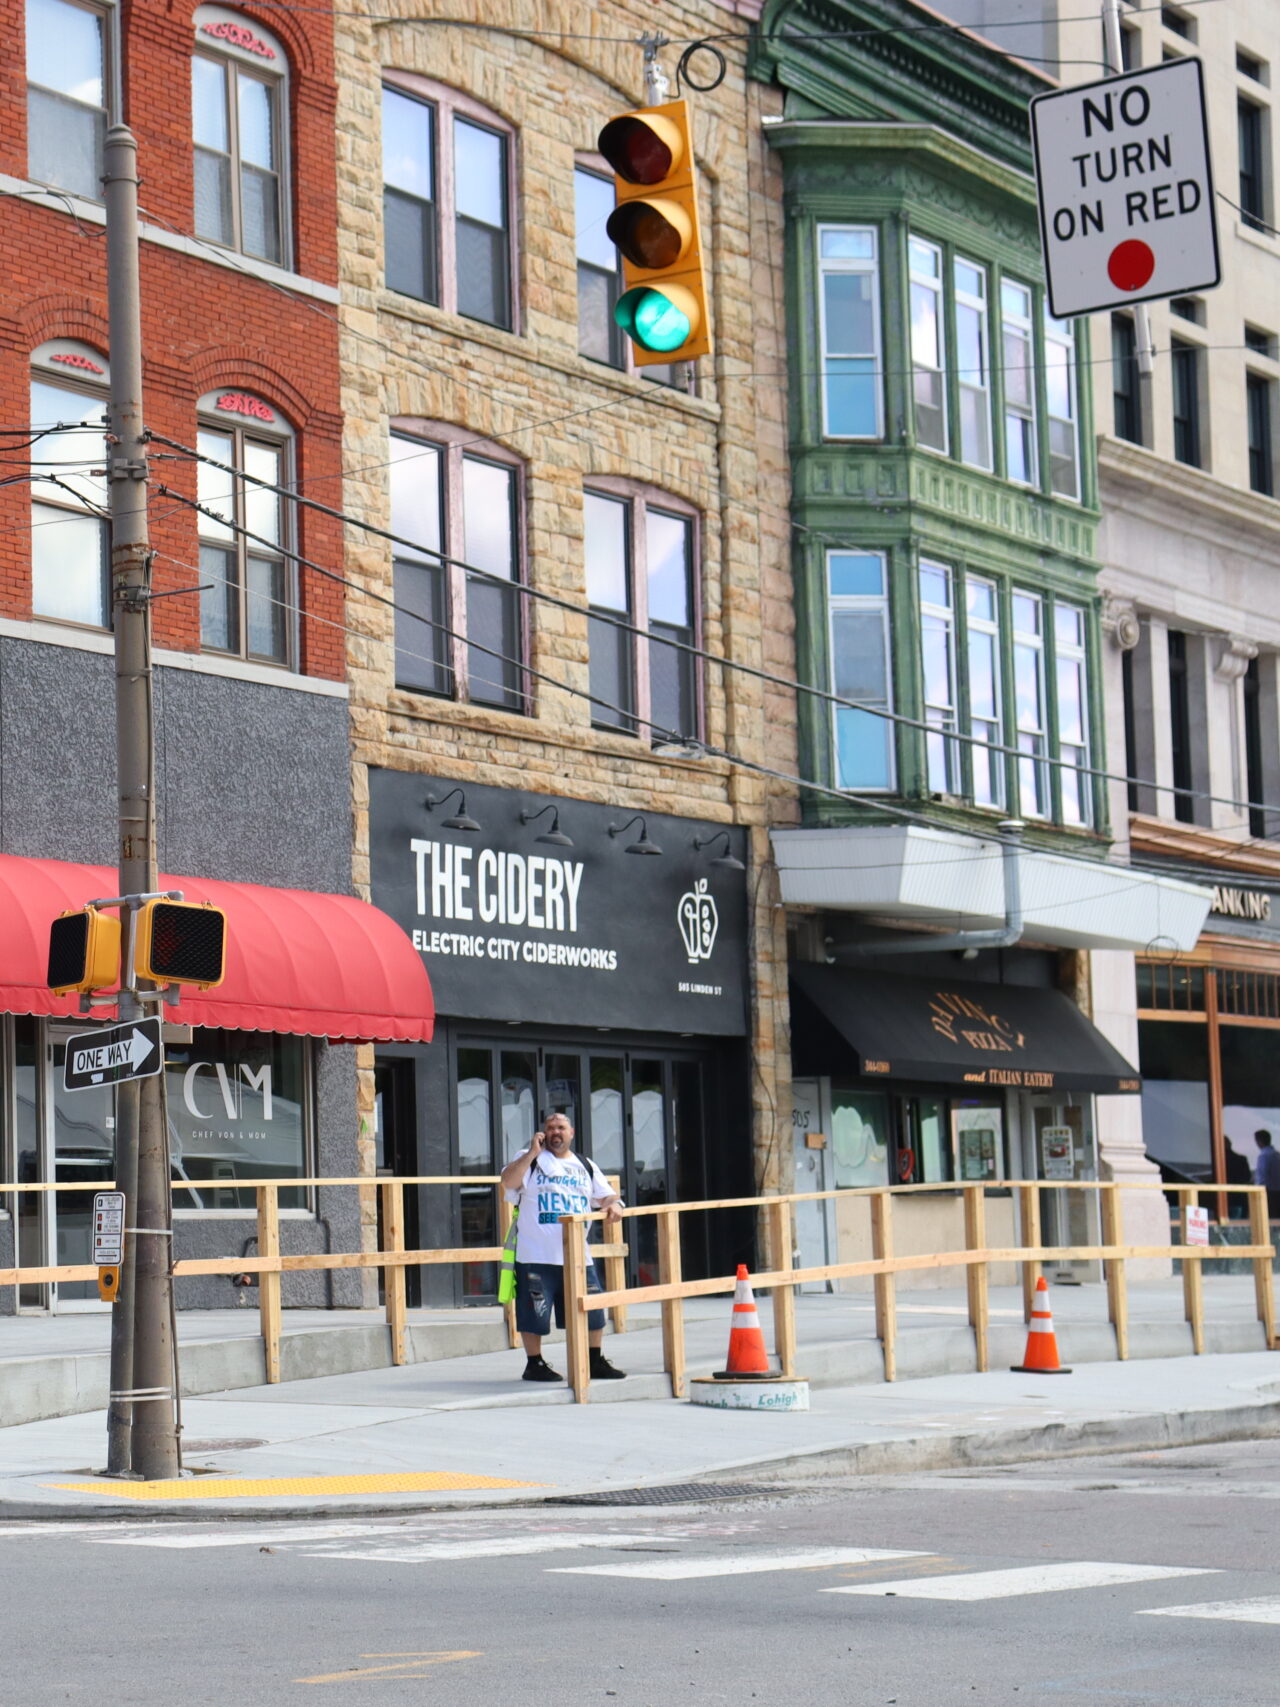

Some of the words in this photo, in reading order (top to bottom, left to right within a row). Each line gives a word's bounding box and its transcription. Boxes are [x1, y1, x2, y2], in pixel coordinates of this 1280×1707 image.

[1082, 85, 1150, 138] NO
[1072, 134, 1172, 188] TURN
[1053, 200, 1104, 242] ON
[1125, 178, 1201, 226] RED
[410, 838, 474, 921] THE
[477, 848, 585, 932] CIDERY
[1212, 885, 1271, 921] ANKING
[412, 929, 485, 958] ELECTRIC
[488, 941, 521, 962] CITY
[523, 942, 618, 971] CIDERWORKS
[77, 1049, 103, 1071] ONE
[108, 1041, 132, 1065] WAY
[183, 1062, 273, 1120] CVM
[964, 1071, 986, 1082] and
[988, 1069, 1021, 1085] ITALIAN
[1023, 1072, 1054, 1087] EATERY
[192, 1131, 213, 1139] CHEF
[218, 1131, 234, 1139] VON
[792, 1109, 810, 1128] 505
[538, 1192, 588, 1213] NEVER
